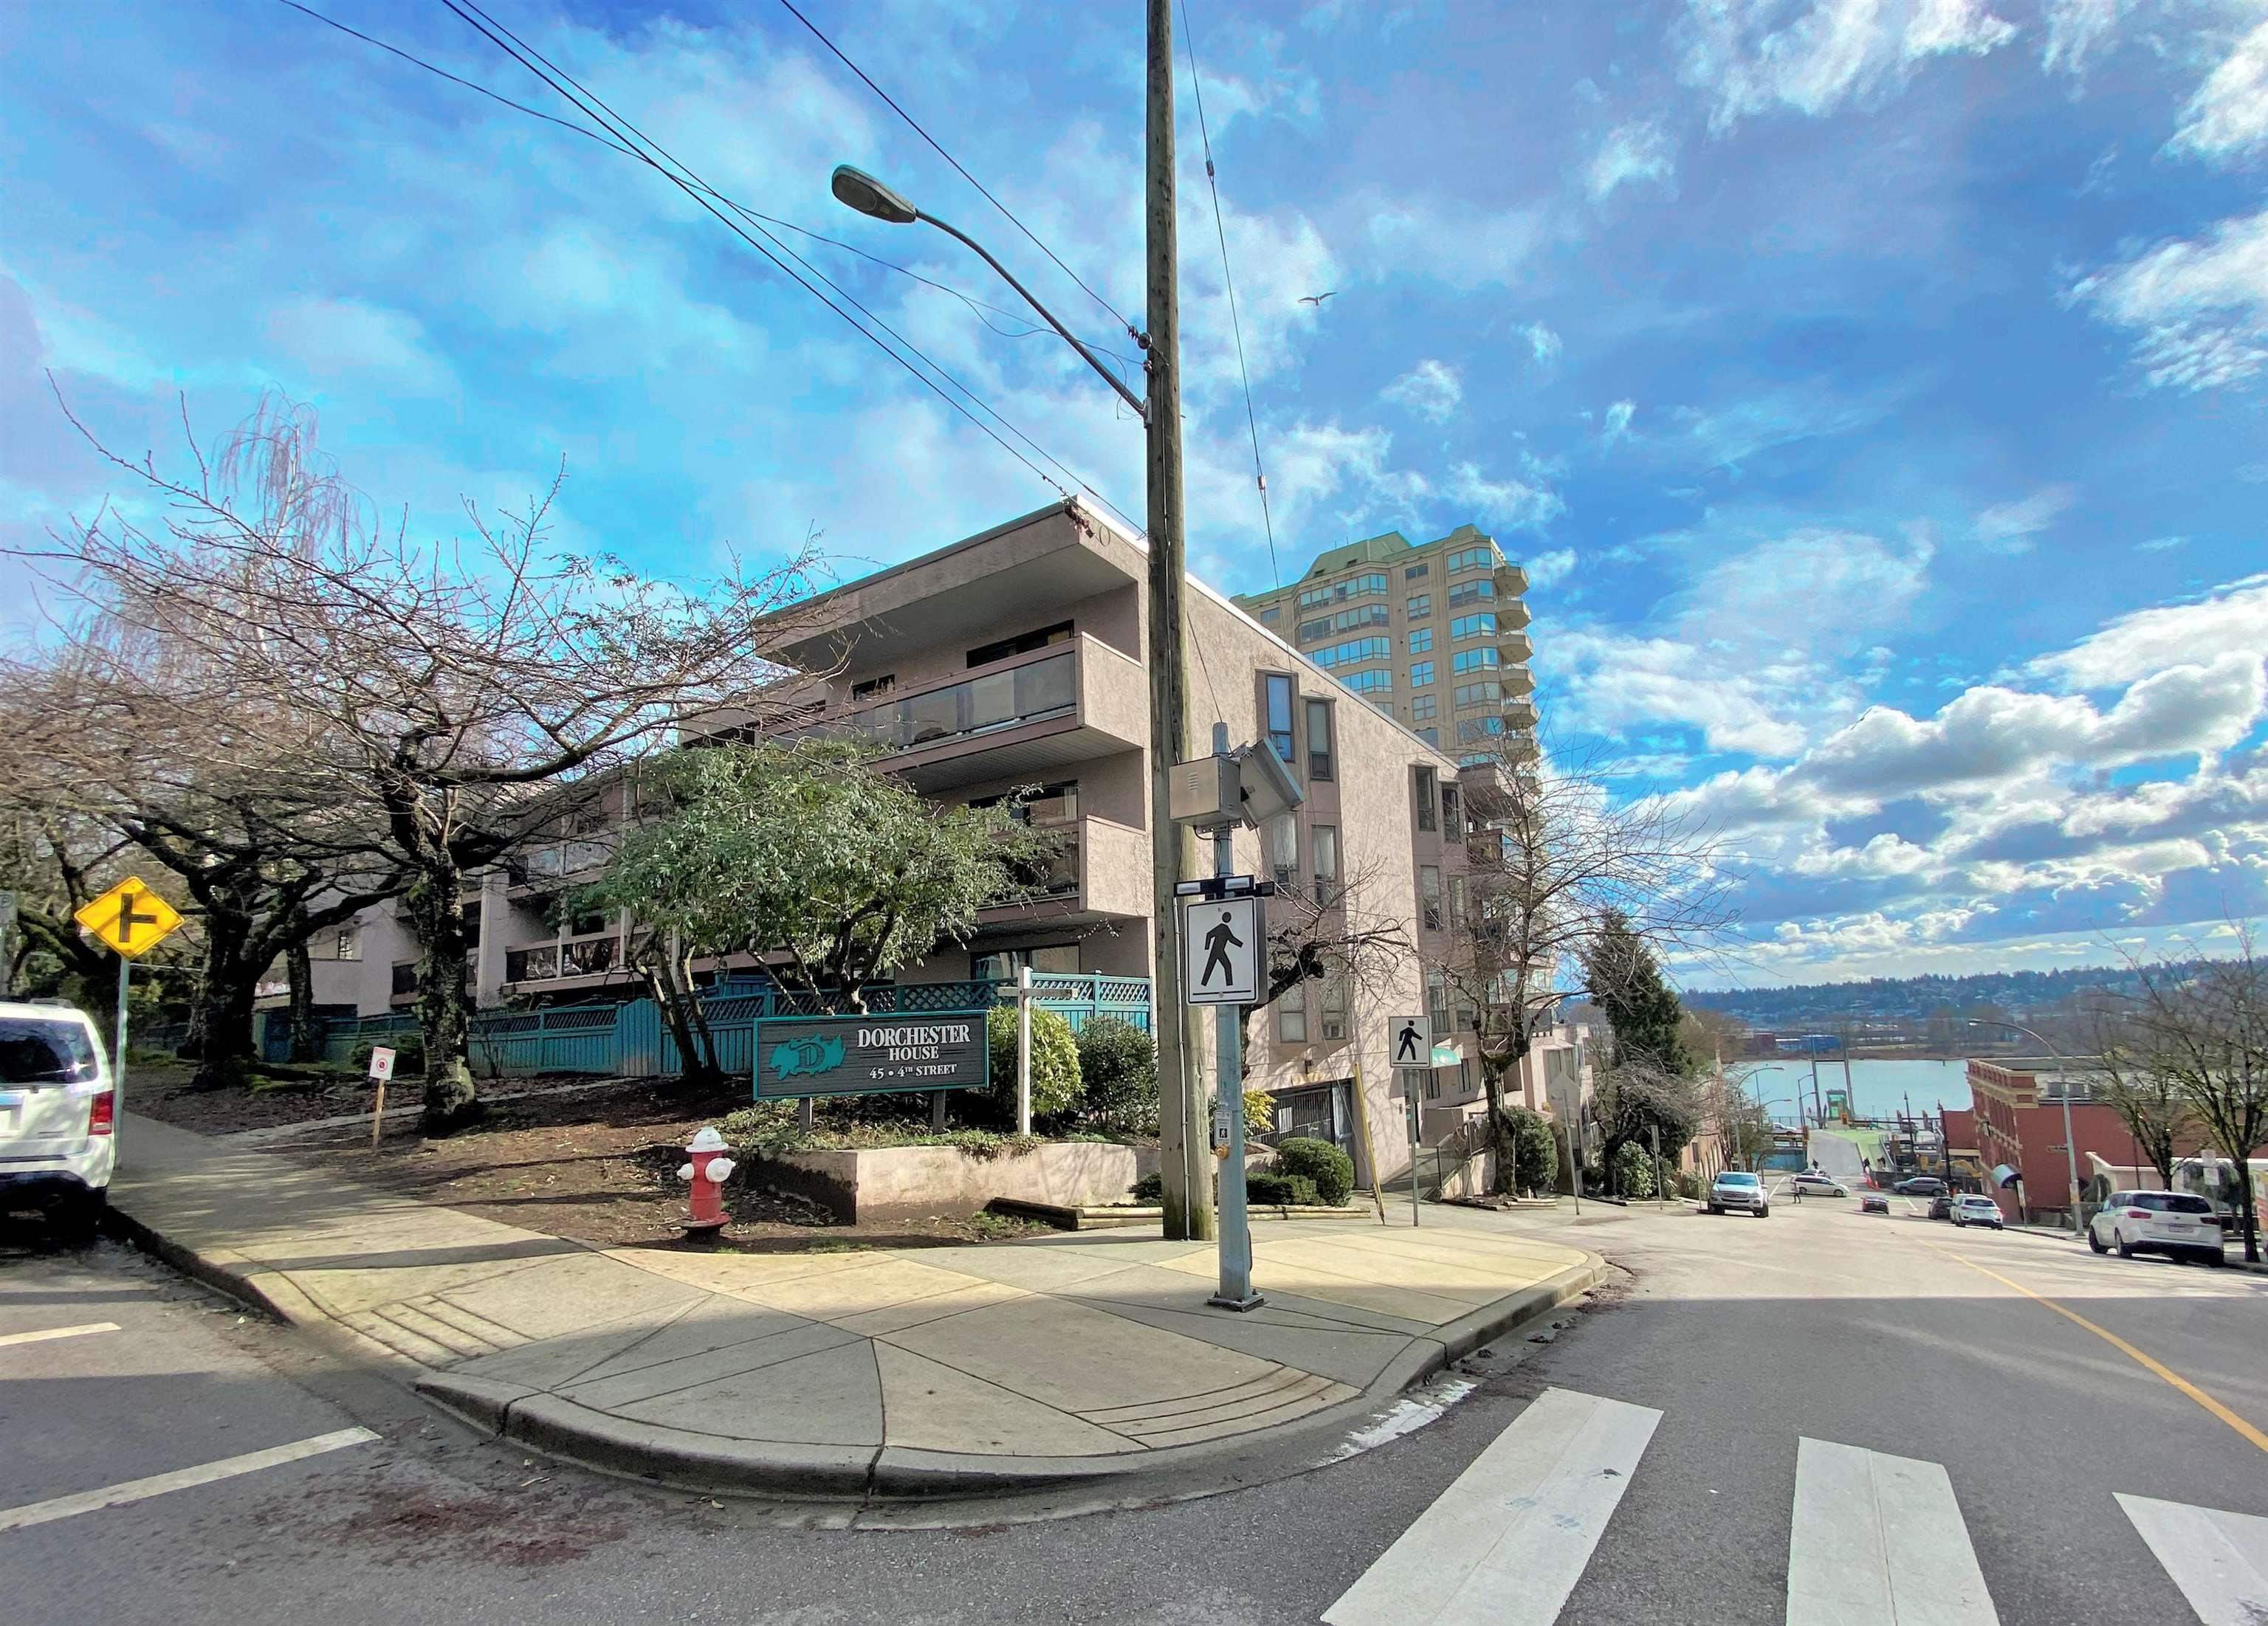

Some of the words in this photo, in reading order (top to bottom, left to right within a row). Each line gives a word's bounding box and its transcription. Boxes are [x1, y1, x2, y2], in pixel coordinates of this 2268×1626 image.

[857, 1024, 971, 1047] DORCHESTER
[888, 1046, 939, 1061] HOUSE
[869, 1067, 884, 1079] 45
[915, 1064, 958, 1076] STREET
